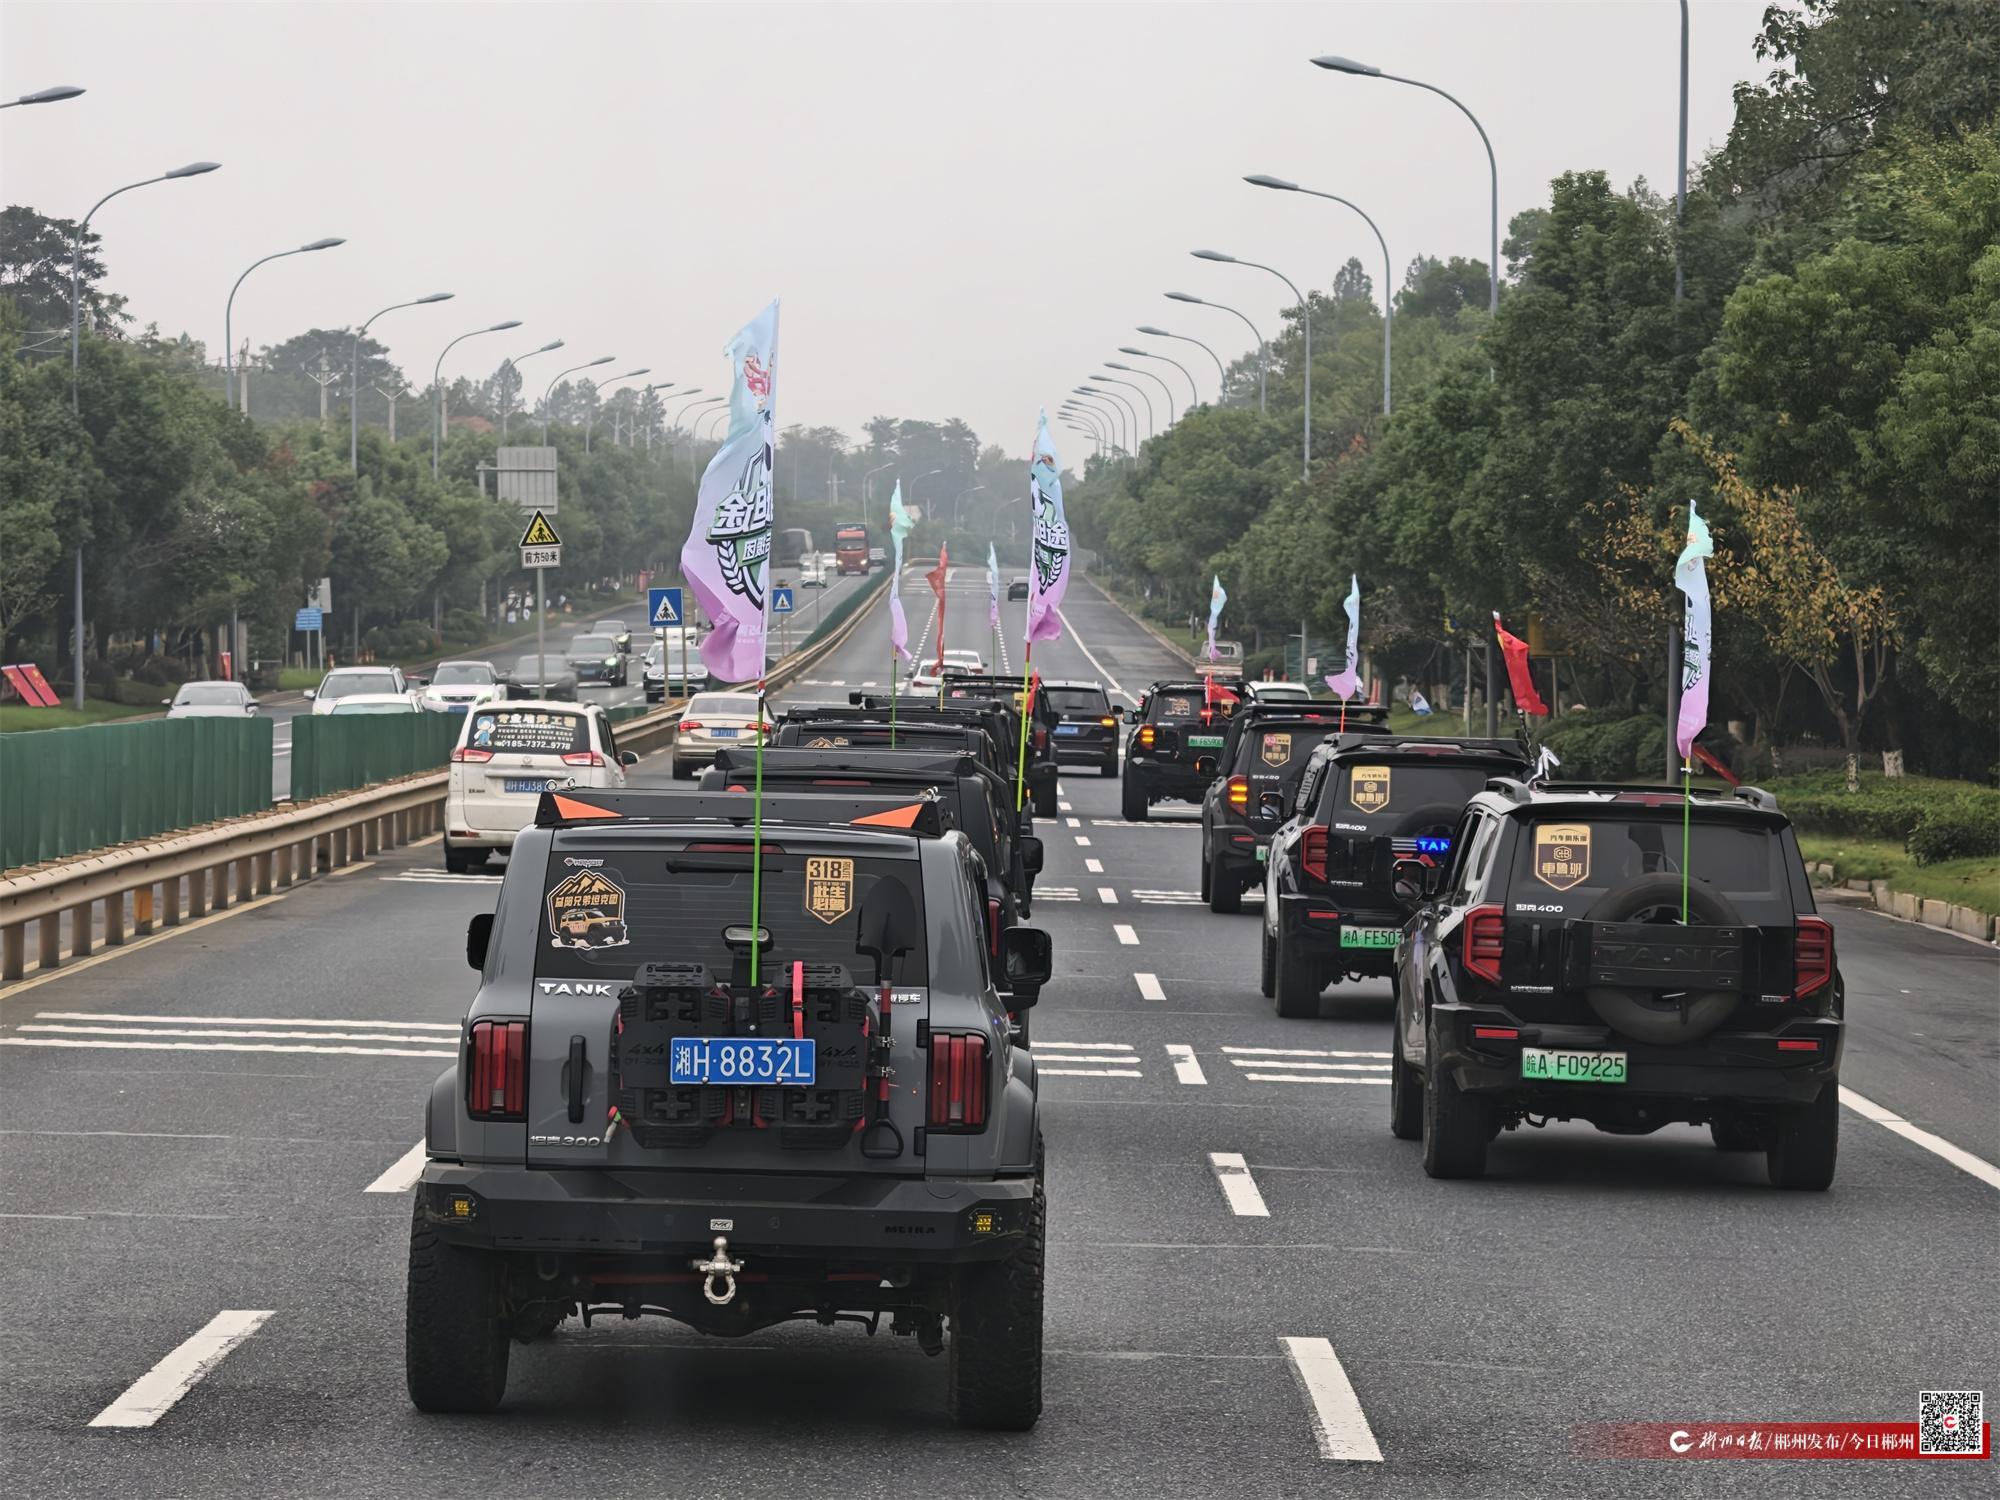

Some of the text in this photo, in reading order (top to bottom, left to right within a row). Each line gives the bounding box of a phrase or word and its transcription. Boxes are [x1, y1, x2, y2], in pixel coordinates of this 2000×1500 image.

[525, 552, 557, 563] 前方50米
[809, 861, 842, 879] 318
[1516, 904, 1563, 912] 坦克400
[538, 983, 612, 997] TANK
[530, 1135, 600, 1146] 坦克300
